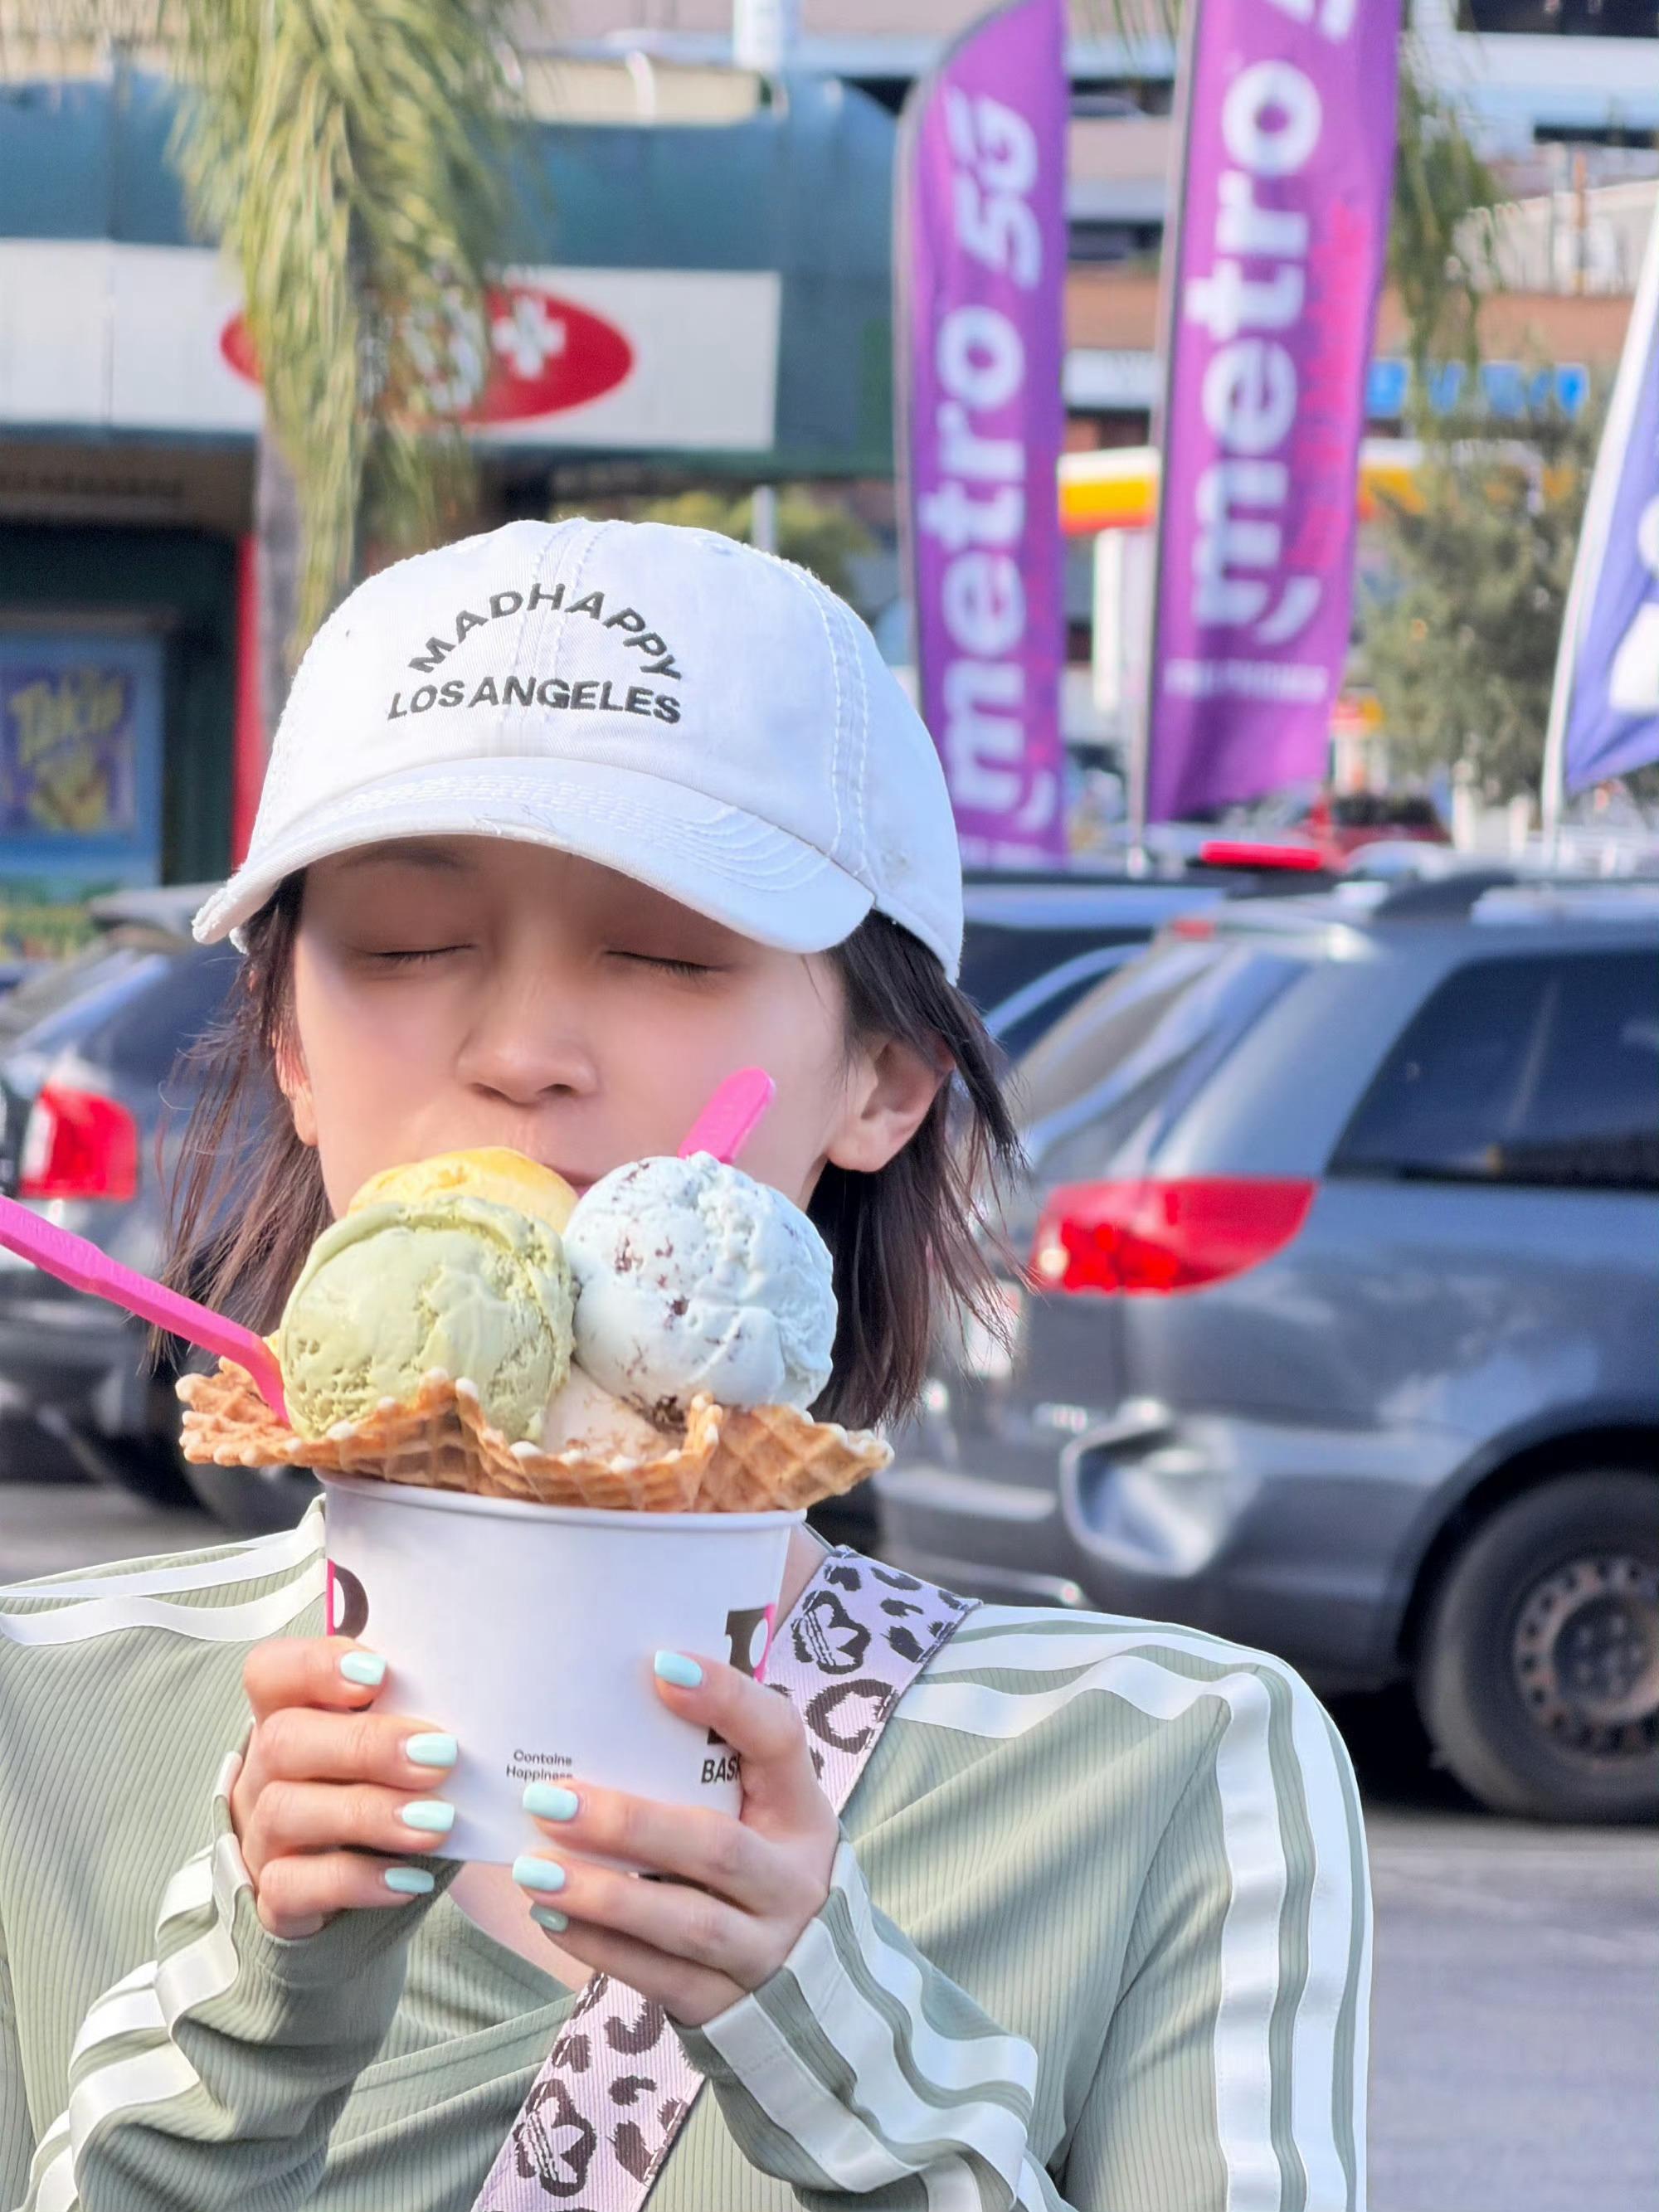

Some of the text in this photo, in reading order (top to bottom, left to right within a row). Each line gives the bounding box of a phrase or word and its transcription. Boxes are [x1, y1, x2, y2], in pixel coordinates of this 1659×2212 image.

[945, 85, 1044, 290] 5G
[1185, 58, 1322, 645] metro
[920, 304, 1055, 829] metro
[407, 582, 683, 682] MADHAPPY
[387, 675, 682, 725] LOS ANGELES
[513, 1748, 573, 1767] Contains
[700, 1755, 741, 1784] BAS
